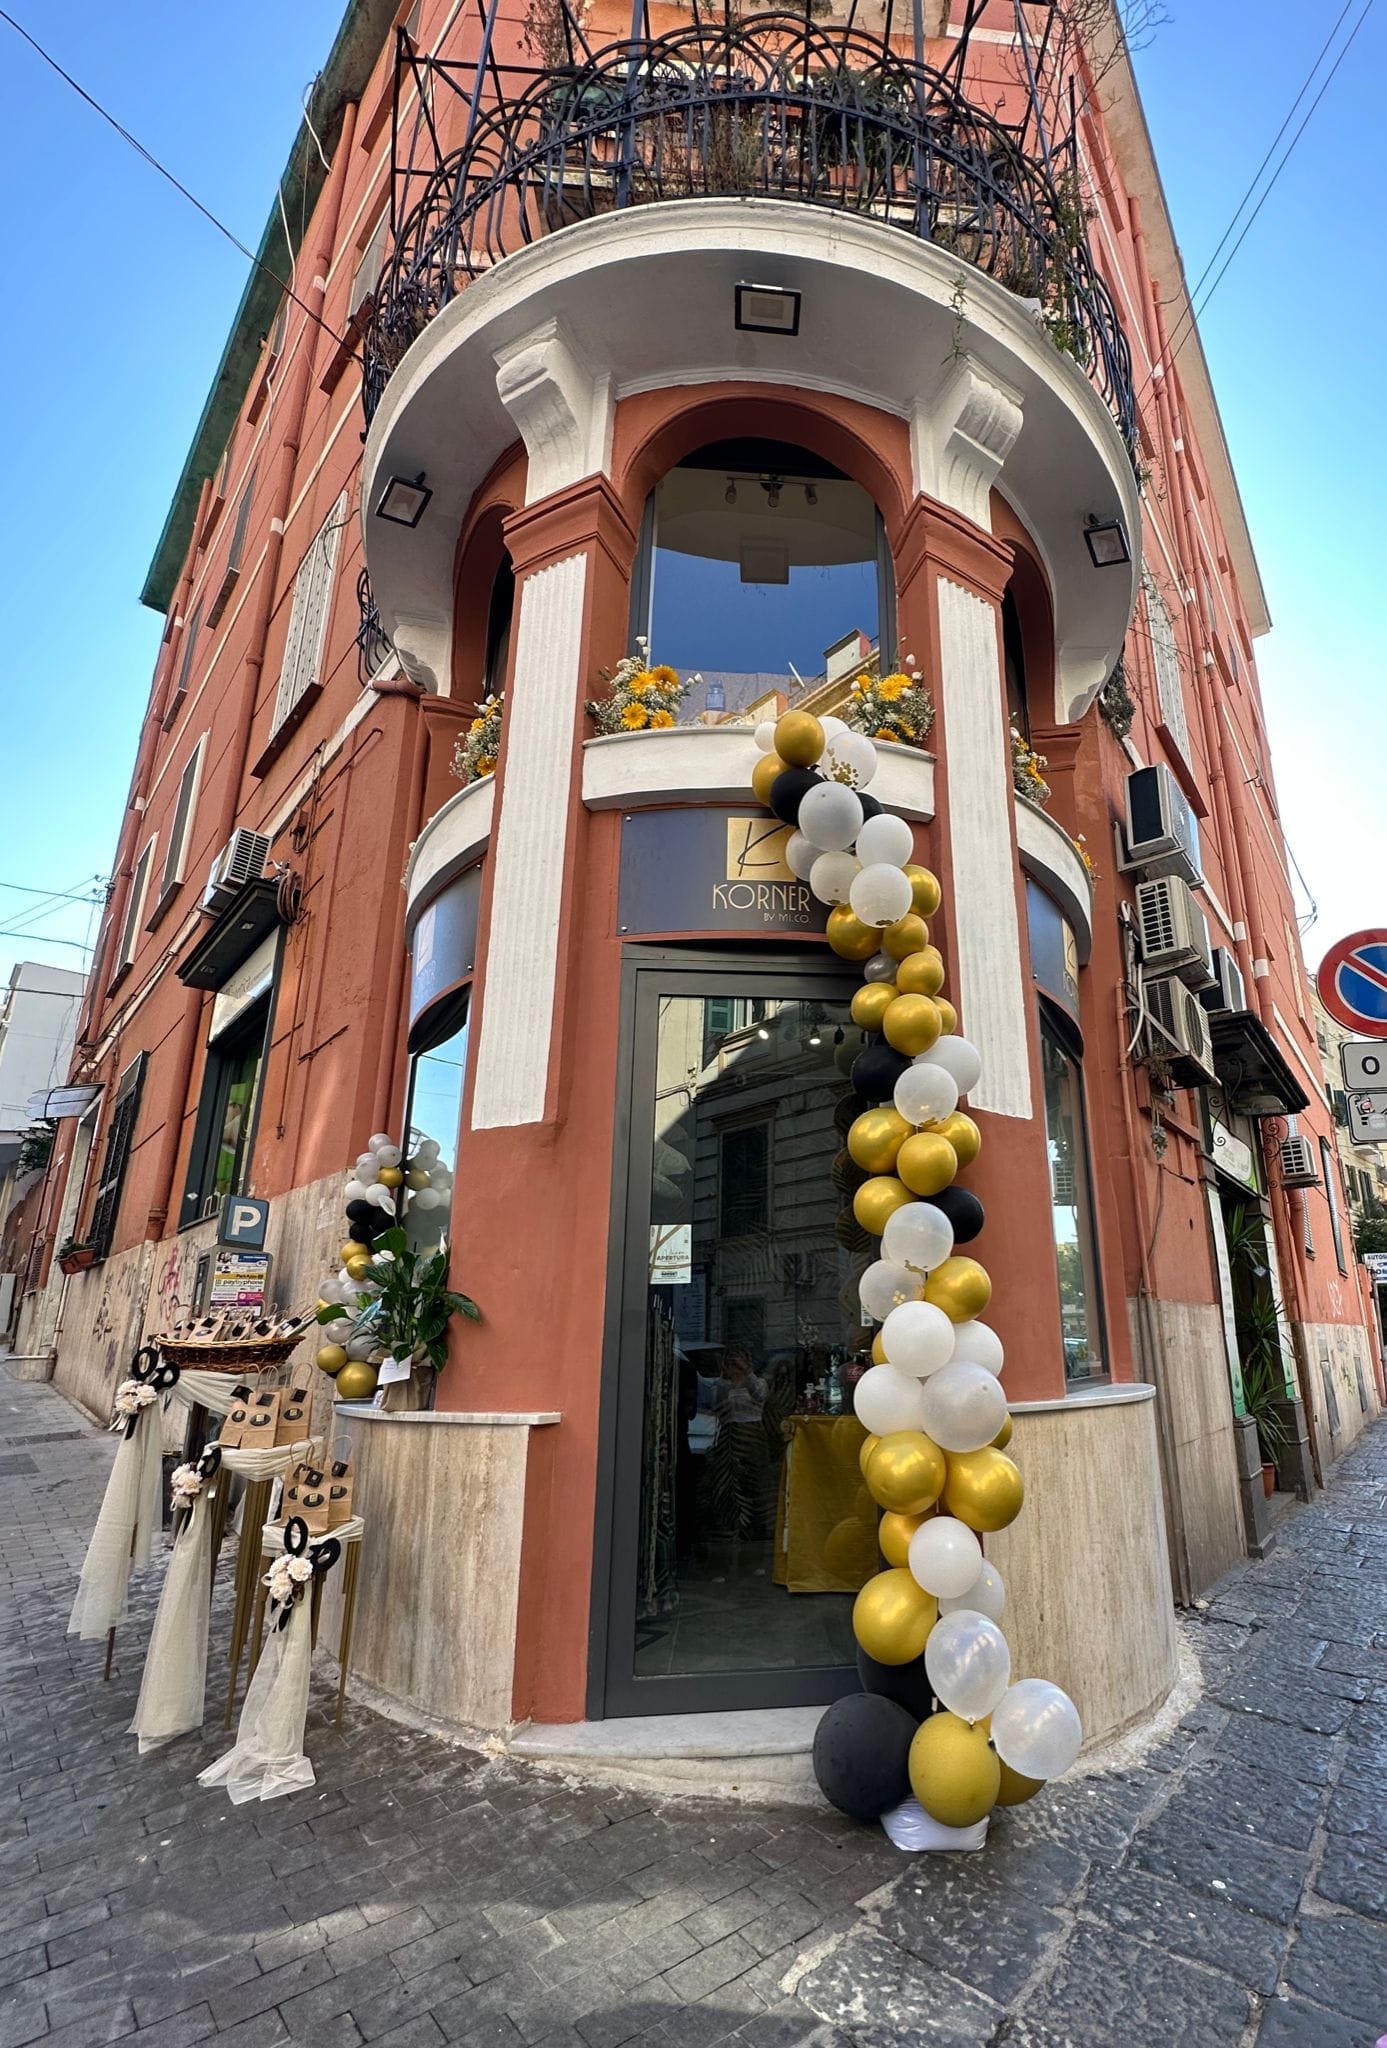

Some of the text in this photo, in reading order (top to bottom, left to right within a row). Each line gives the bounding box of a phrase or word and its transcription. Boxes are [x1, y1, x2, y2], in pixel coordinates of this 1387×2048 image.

[712, 884, 811, 912] KORNER
[763, 912, 775, 923] BY
[230, 1205, 262, 1236] P
